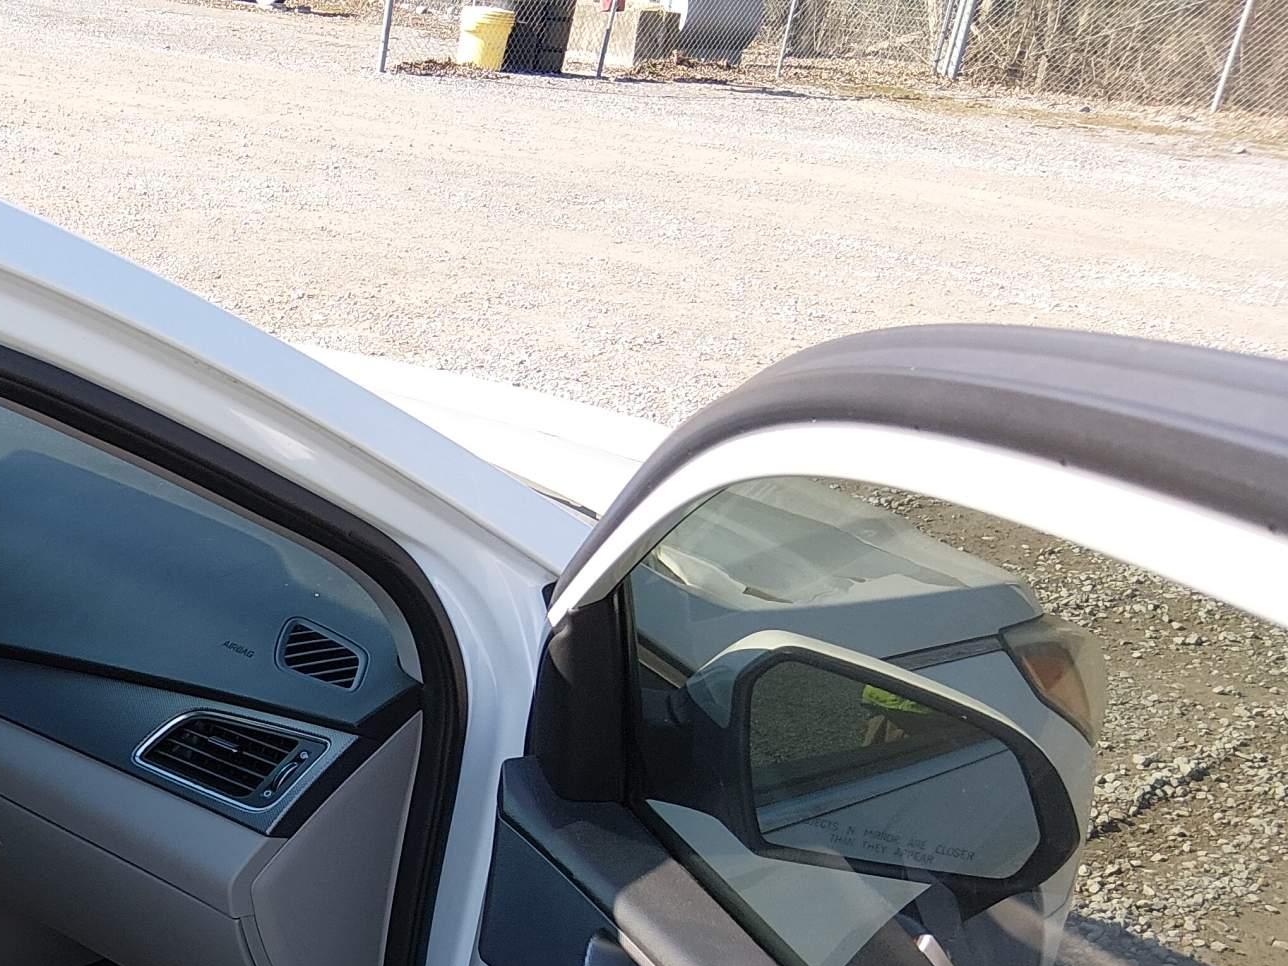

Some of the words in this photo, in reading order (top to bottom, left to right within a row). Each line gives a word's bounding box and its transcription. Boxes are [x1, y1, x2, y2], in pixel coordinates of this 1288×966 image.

[222, 639, 255, 658] AIRBAG
[830, 833, 855, 848] THAN
[863, 840, 887, 854] THEY
[893, 847, 935, 865] APPEAR
[908, 837, 928, 850] ARE
[935, 843, 975, 861] CLOSER
